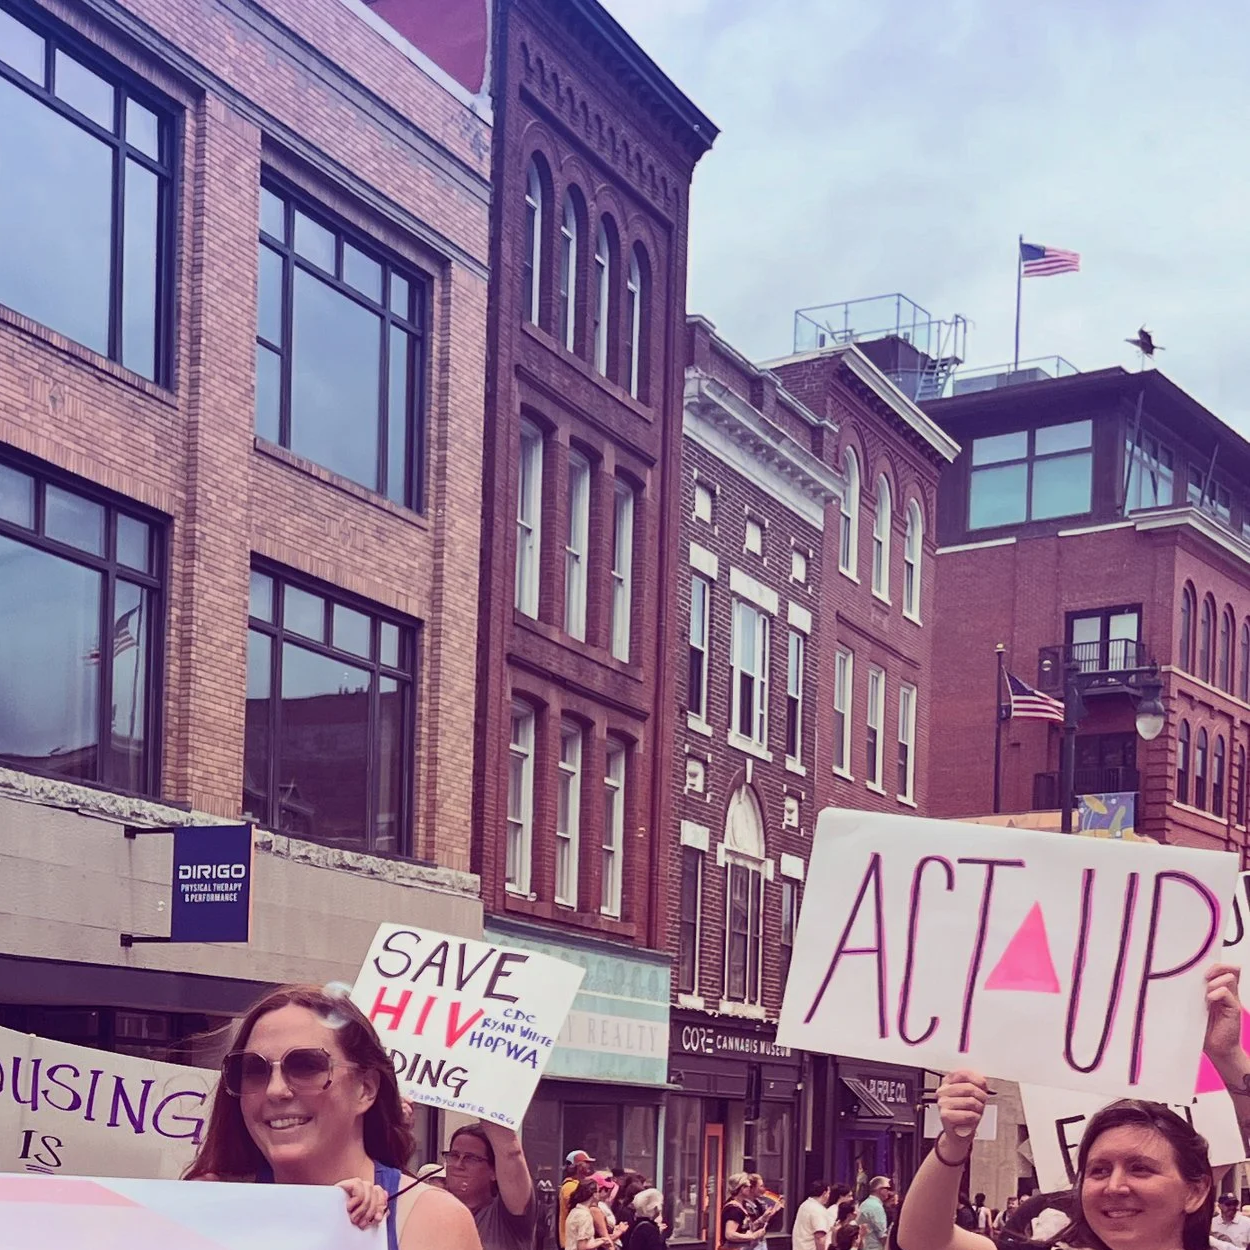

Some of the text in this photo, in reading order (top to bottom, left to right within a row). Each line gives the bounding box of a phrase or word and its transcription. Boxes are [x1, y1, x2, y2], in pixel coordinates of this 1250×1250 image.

[178, 863, 246, 879] DIRIGO
[180, 883, 242, 892] PHYSICAL THERAPY
[190, 893, 238, 902] PERFORMANCE
[373, 930, 530, 1004] SAVE
[803, 852, 1221, 1087] ACT UP
[369, 986, 485, 1049] HIV
[481, 1017, 516, 1034] RYAN
[503, 1008, 537, 1024] CDC
[587, 1015, 659, 1052] REALTY
[682, 1025, 793, 1058] CORE CANNABIS MUSEUM
[384, 1047, 469, 1098] DING
[18, 1129, 64, 1168] IS
